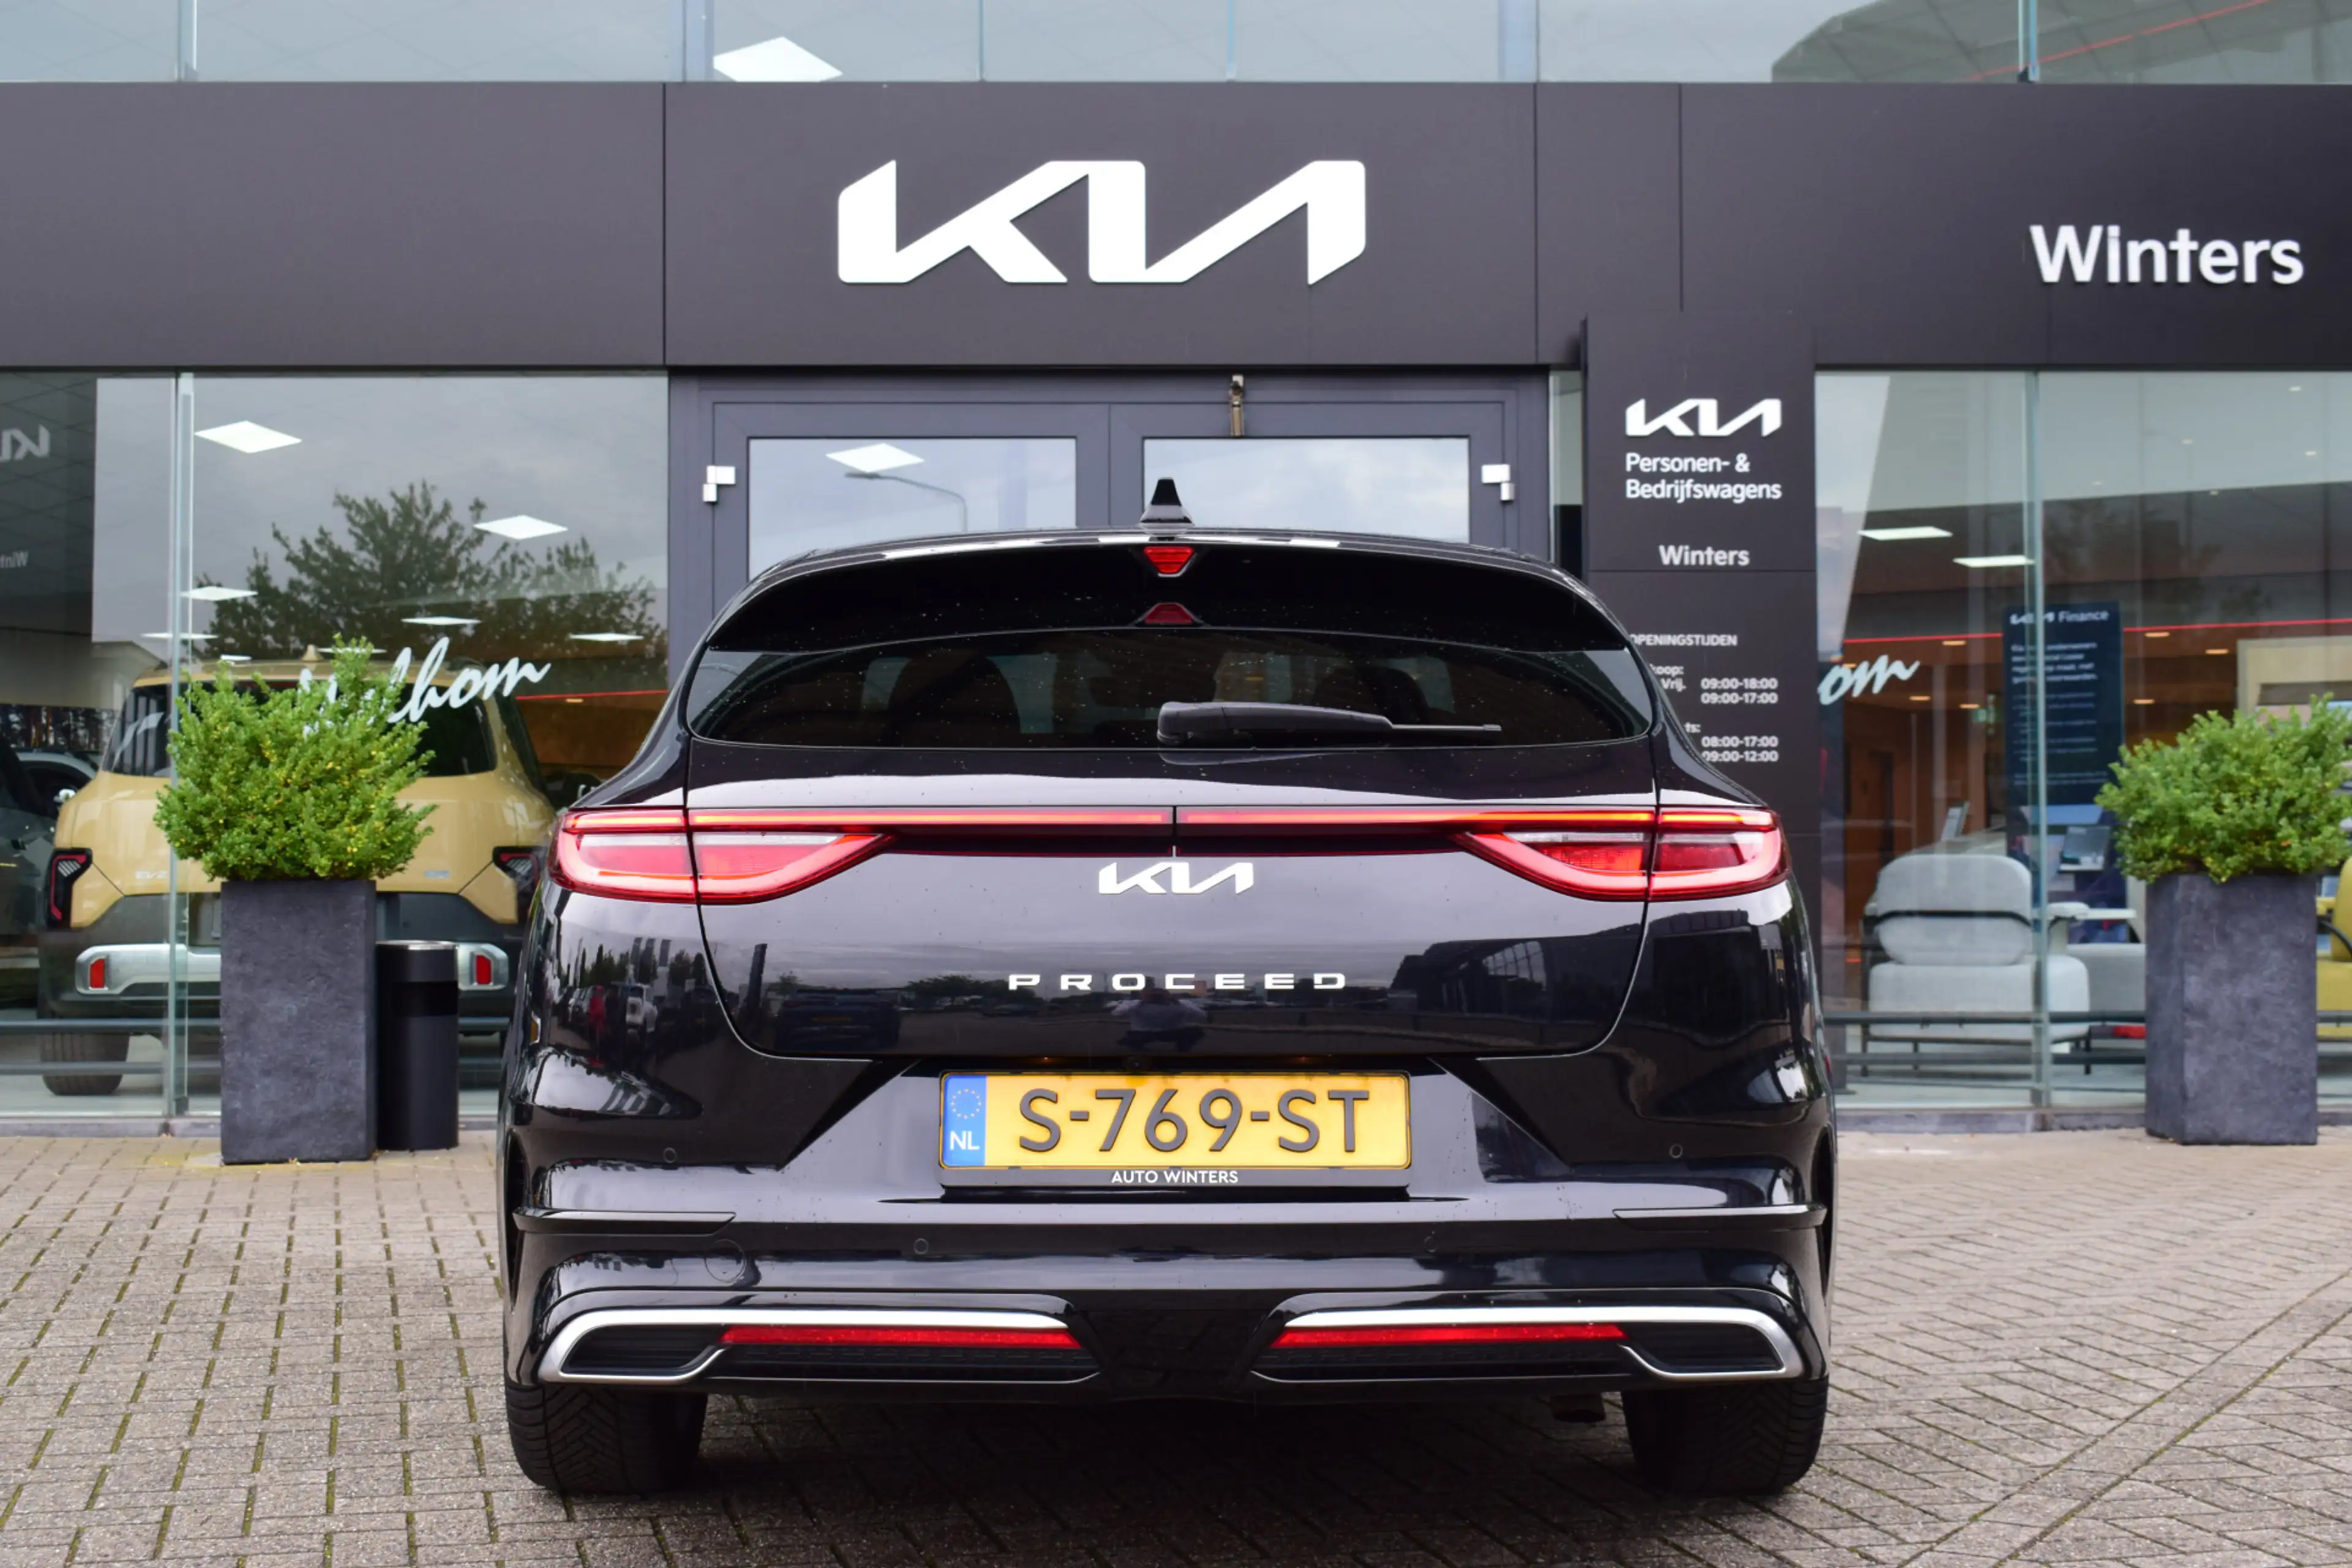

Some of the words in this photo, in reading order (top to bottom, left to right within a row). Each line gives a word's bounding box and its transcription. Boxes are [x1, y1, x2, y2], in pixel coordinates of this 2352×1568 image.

[839, 160, 1365, 285] KIA
[2029, 225, 2304, 284] Winters
[1626, 398, 1782, 437] KIA
[1626, 453, 1730, 472] Personen-
[1735, 453, 1750, 472] &
[1626, 479, 1782, 503] Bedrijfswagens
[1659, 545, 1750, 566] Winters
[2058, 609, 2110, 624] Finance
[1700, 678, 1778, 690] 09:00-18:00
[1700, 693, 1778, 704] 09:00-17:00
[1701, 736, 1779, 748] 08:00-17:00
[1099, 862, 1253, 894] KIA
[1008, 973, 1346, 990] PROCEED
[1019, 1088, 1369, 1152] S-769-ST
[949, 1131, 980, 1150] NL
[1110, 1170, 1158, 1183] AUTO
[1163, 1170, 1238, 1184] WINTERS
